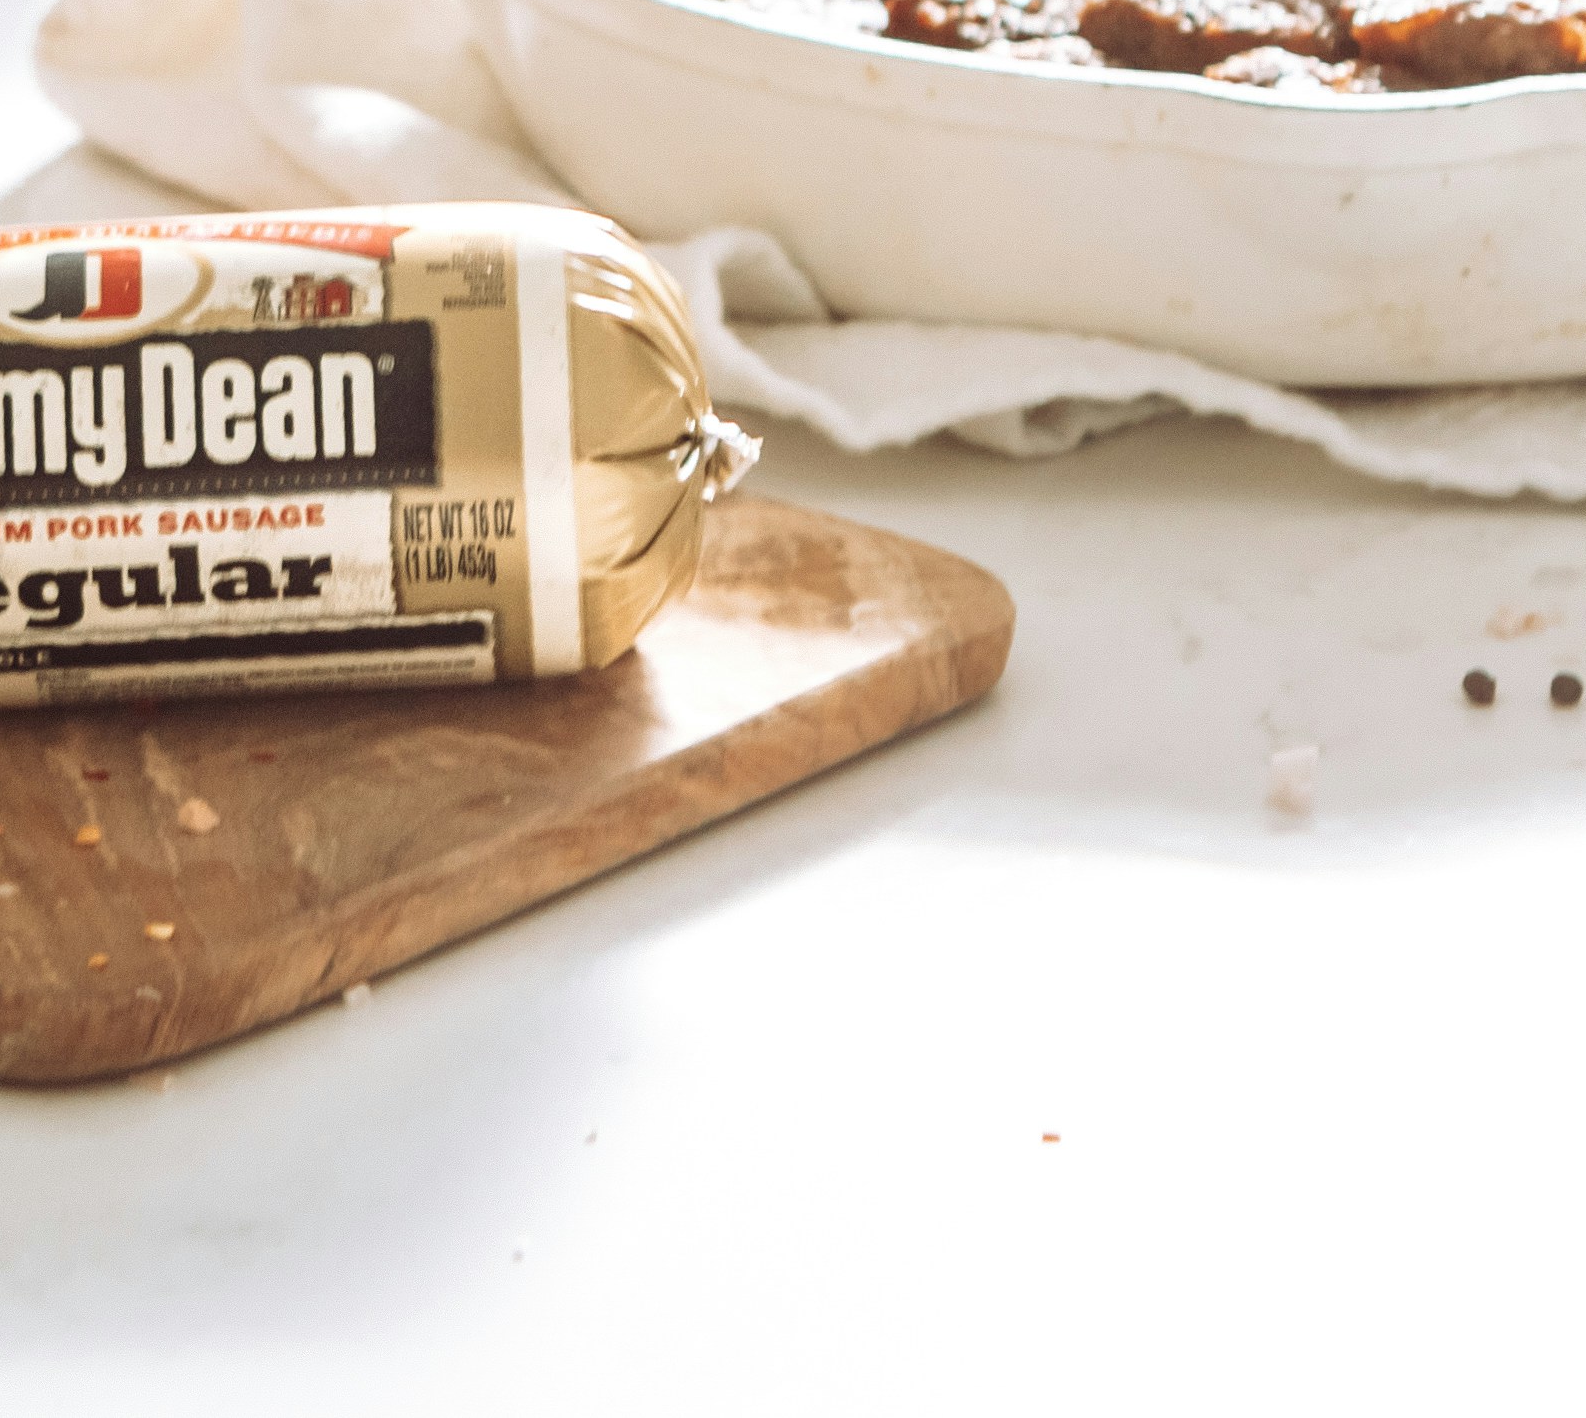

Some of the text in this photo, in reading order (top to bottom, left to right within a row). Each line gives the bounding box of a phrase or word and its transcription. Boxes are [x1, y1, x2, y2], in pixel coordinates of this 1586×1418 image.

[141, 342, 377, 469] Dean
[47, 511, 144, 541] PORK
[157, 502, 326, 535] SAUSAGE
[403, 497, 515, 542] NET WT 16 OZ
[405, 545, 420, 584] (1
[426, 545, 453, 583] LB)
